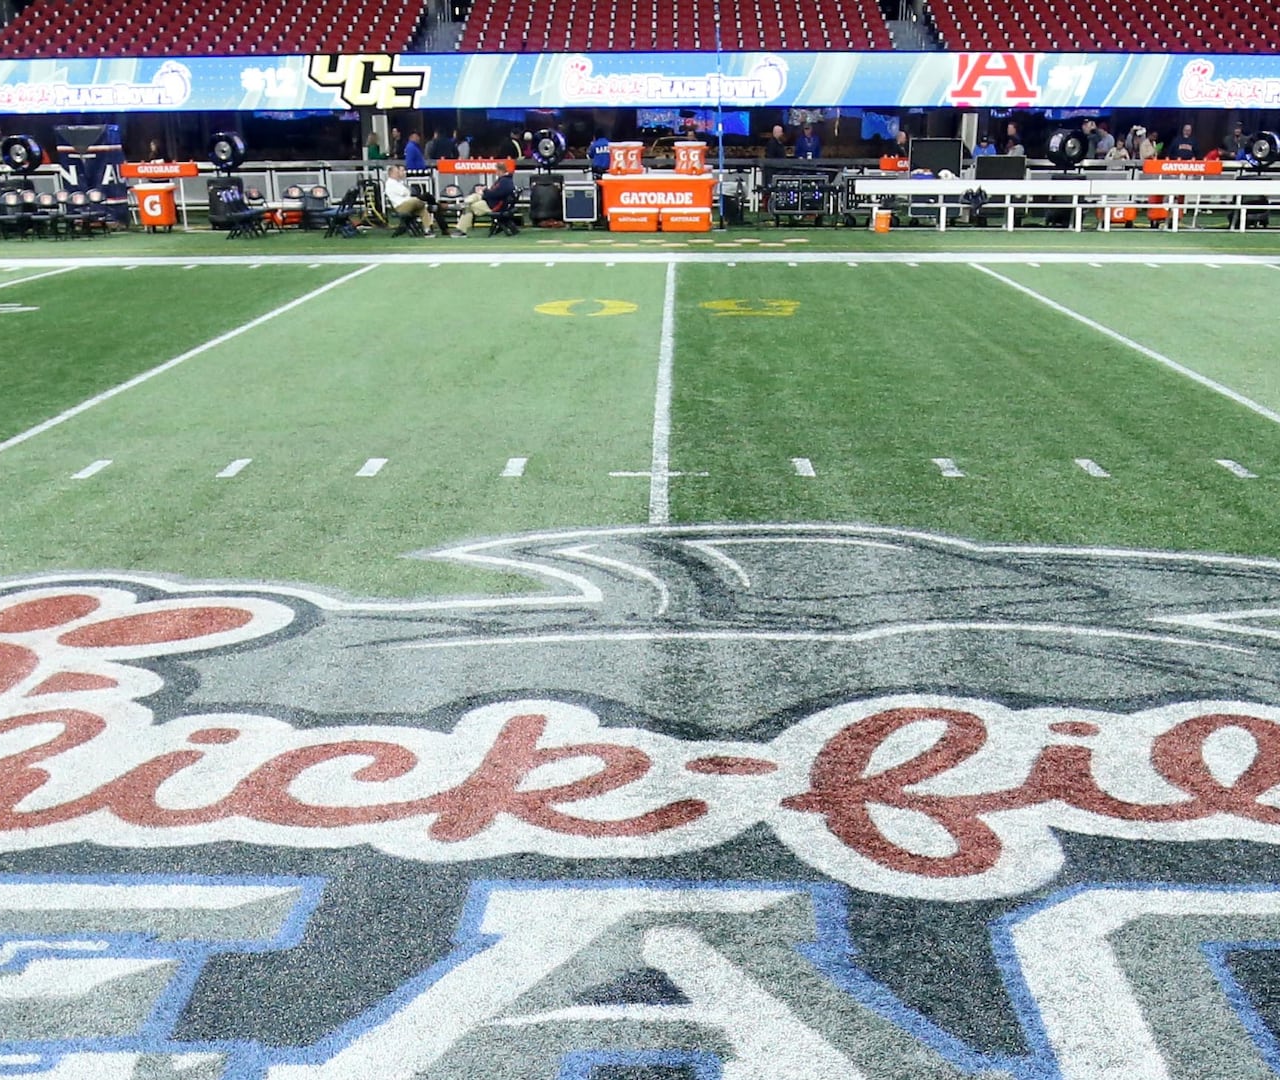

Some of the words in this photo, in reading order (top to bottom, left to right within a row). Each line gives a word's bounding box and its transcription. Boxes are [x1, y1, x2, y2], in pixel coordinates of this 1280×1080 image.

[137, 165, 181, 174] GATORADE
[1161, 162, 1206, 172] GATORADE
[620, 192, 693, 205] GATORADE
[143, 195, 162, 217] G
